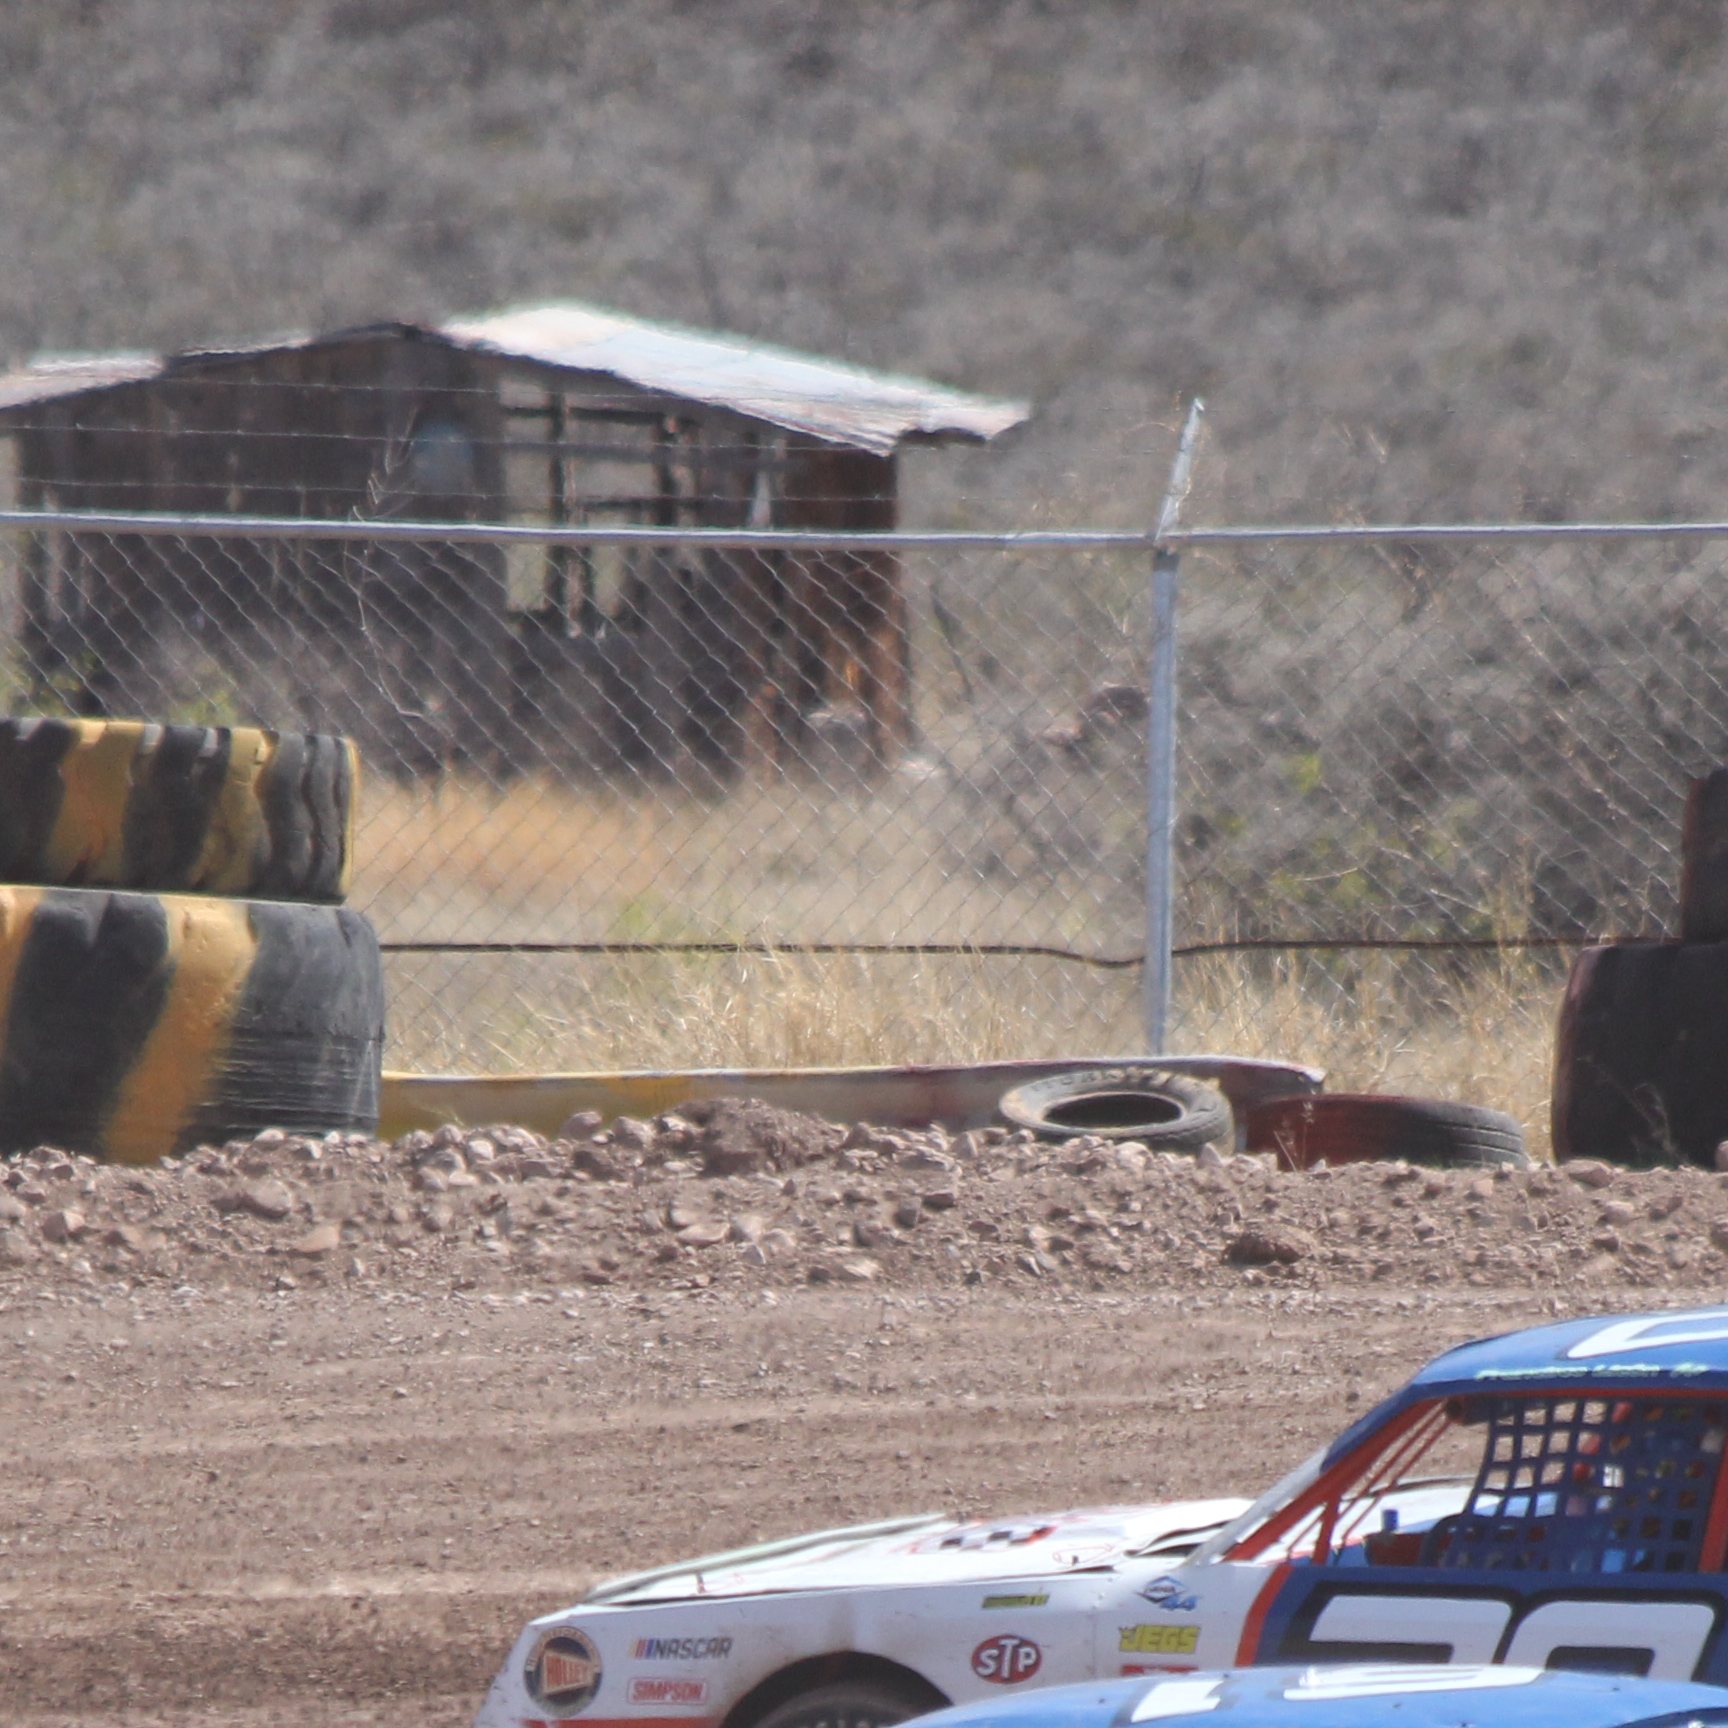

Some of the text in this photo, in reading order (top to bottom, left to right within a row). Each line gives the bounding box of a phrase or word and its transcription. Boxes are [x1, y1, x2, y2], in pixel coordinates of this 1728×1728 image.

[652, 1637, 733, 1660] NASCAR
[1120, 1625, 1200, 1653] JEGS
[976, 1637, 1038, 1679] STP
[632, 1680, 704, 1700] SIMPSON
